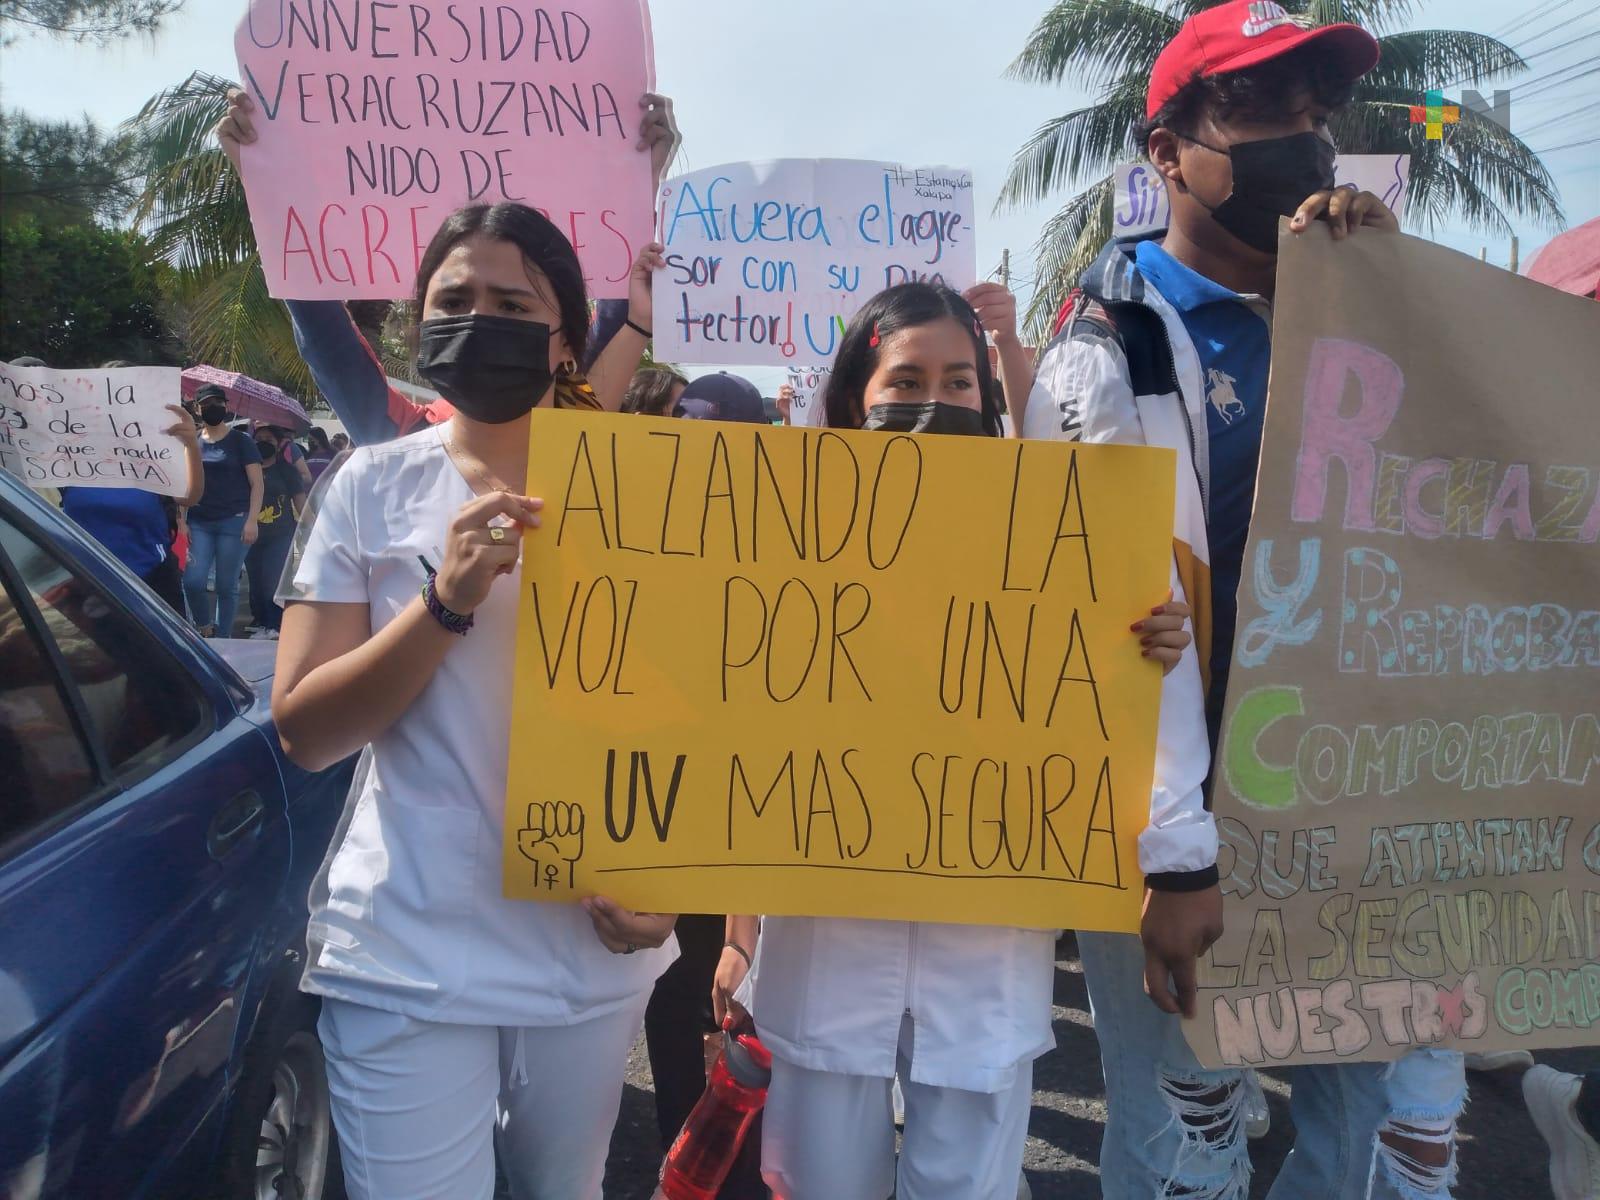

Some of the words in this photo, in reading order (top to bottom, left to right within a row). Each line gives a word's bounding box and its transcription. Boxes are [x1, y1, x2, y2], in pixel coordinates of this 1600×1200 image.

[248, 0, 591, 63] UNIVERSIDAD
[244, 60, 627, 139] VERACRUZANA
[346, 141, 440, 197] NIDO
[460, 149, 526, 201] DE
[284, 203, 633, 286] AGREES
[660, 177, 832, 247] ¡Afuera
[858, 173, 895, 247] el
[900, 209, 972, 264] agre-
[665, 255, 721, 287] sor
[742, 256, 797, 292] con
[828, 266, 859, 292] su
[49, 410, 86, 435] de
[108, 413, 142, 438] la
[106, 377, 136, 405] la
[56, 444, 97, 461] que
[114, 443, 172, 460] nadie
[556, 430, 923, 571] ALZANDO
[1001, 443, 1098, 603] LA
[1236, 538, 1323, 669] Y
[532, 575, 639, 695] VOZ
[721, 575, 872, 703] POR
[939, 595, 1110, 742] UNA
[604, 749, 688, 843] UV
[727, 749, 873, 860] MAS
[906, 752, 1122, 890] SEGURA
[1215, 816, 1339, 900] QUE
[1360, 815, 1574, 889] ATENTAN
